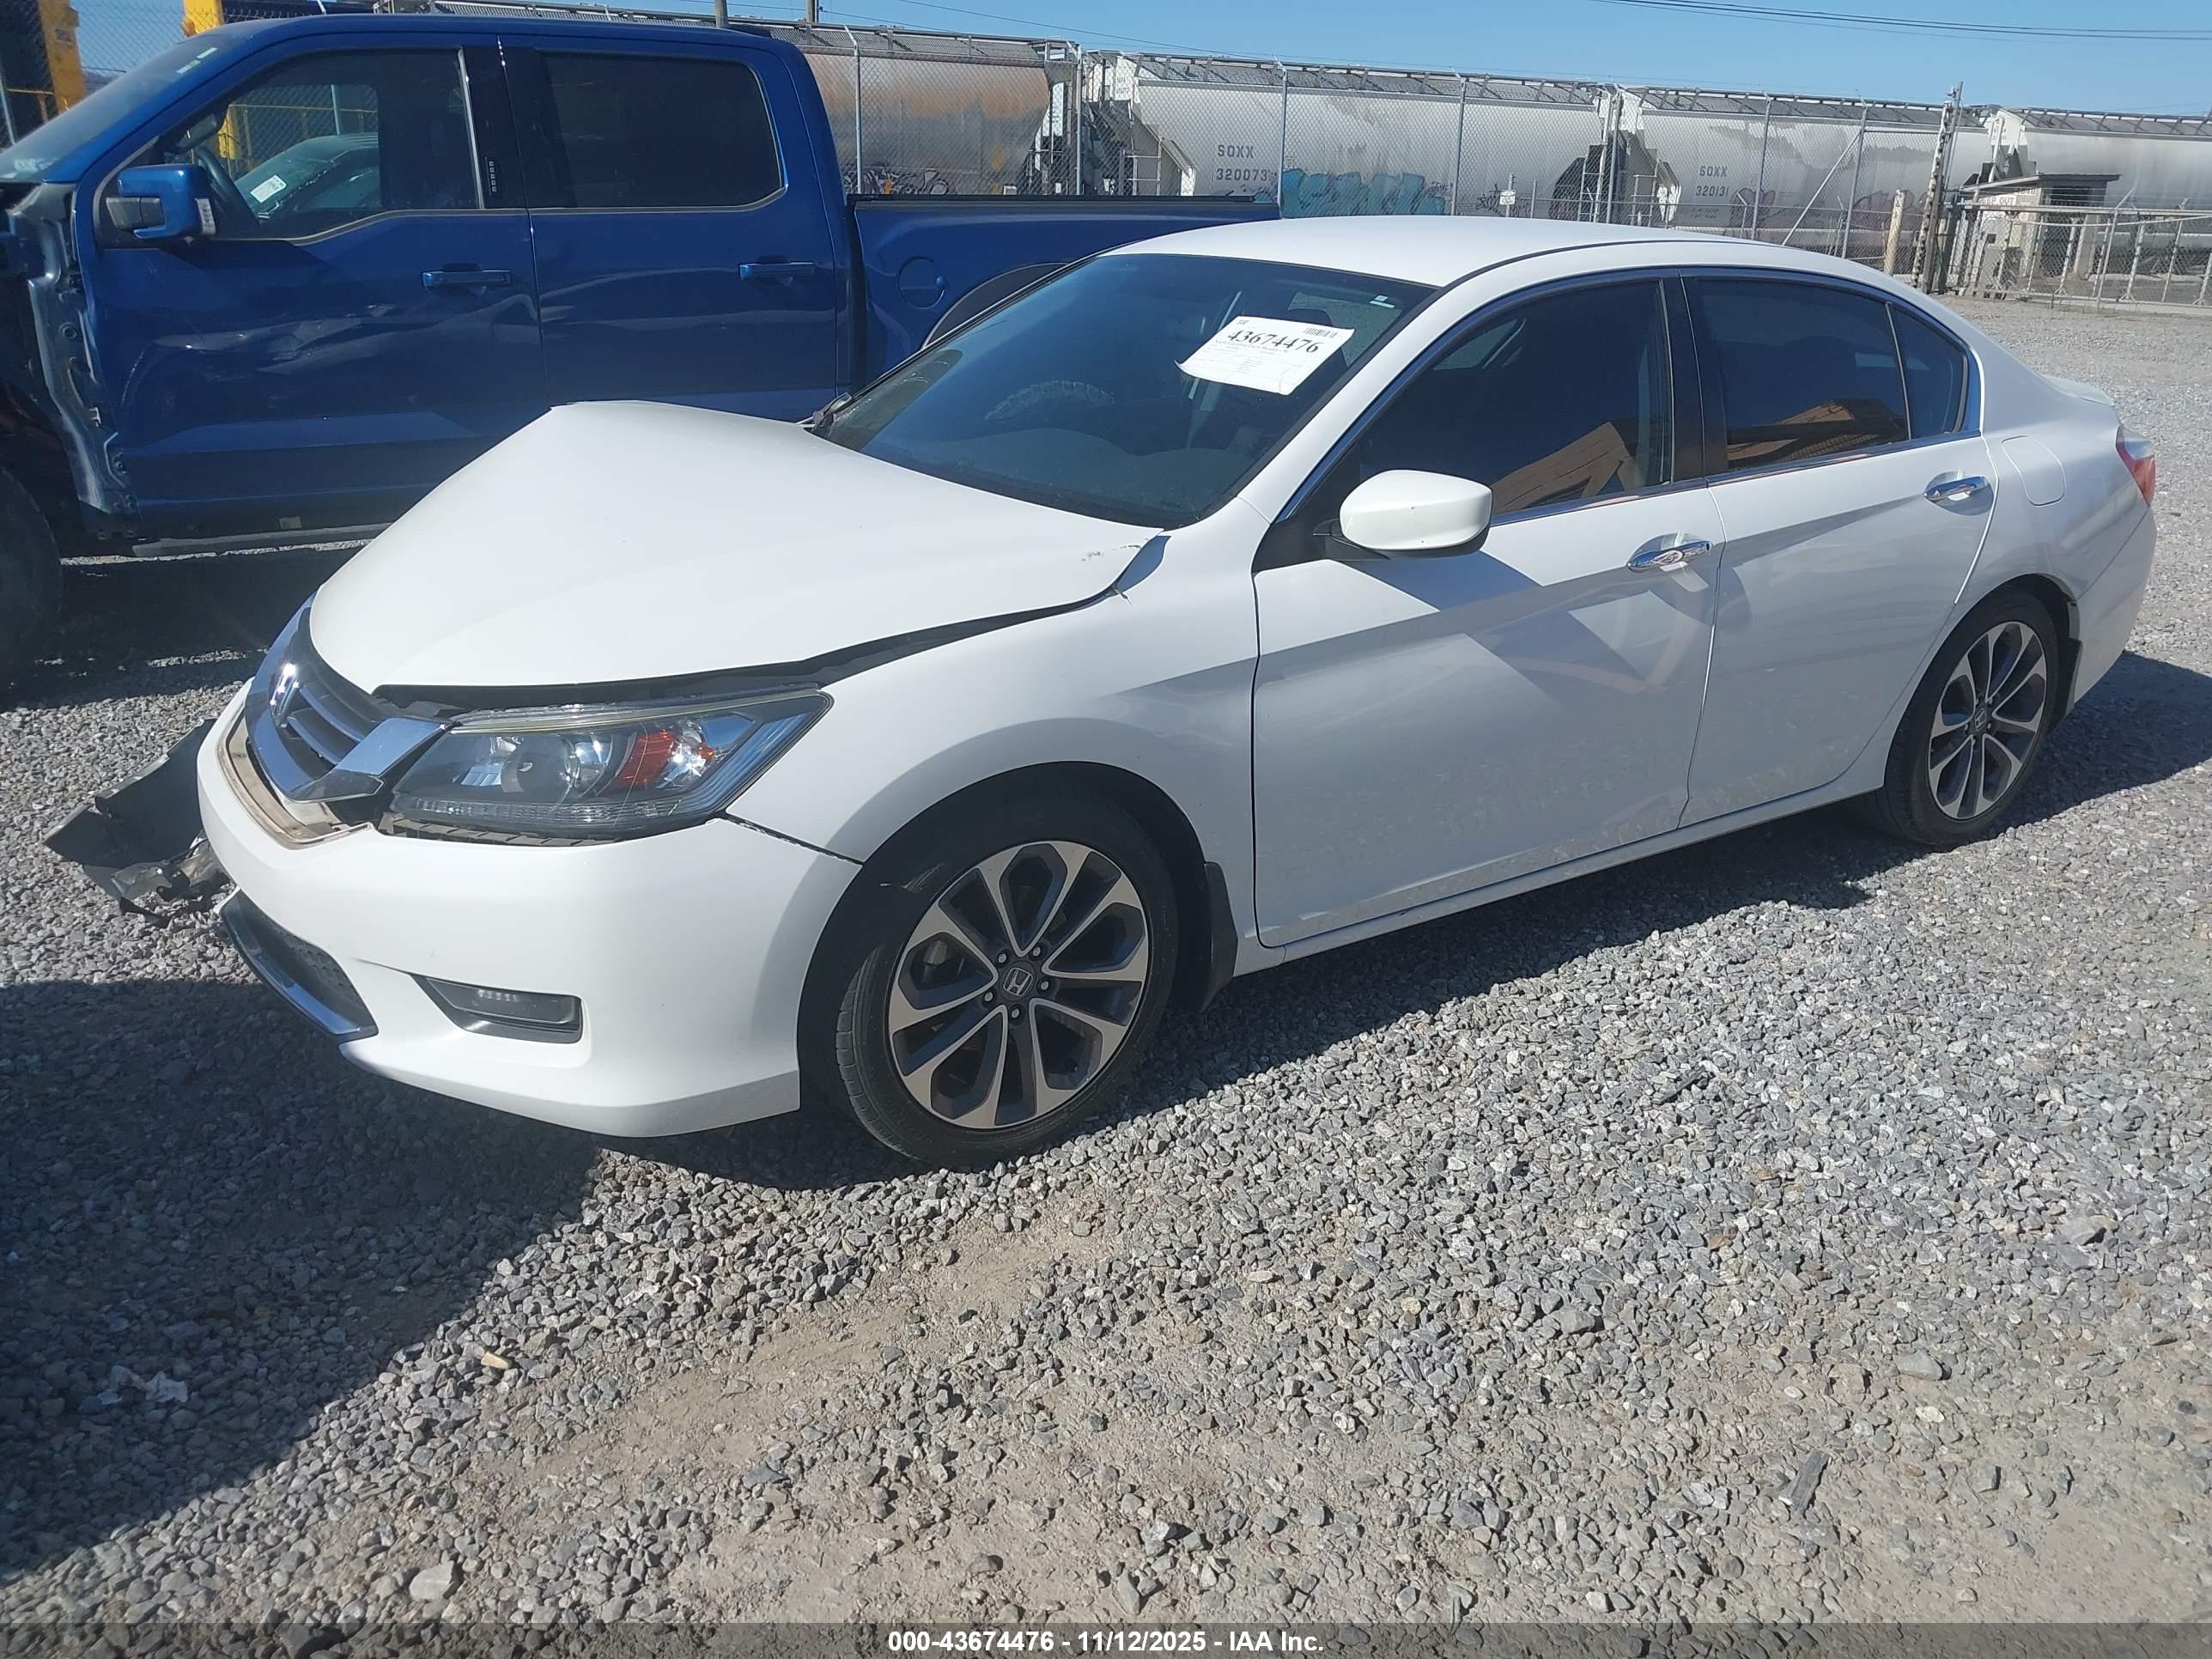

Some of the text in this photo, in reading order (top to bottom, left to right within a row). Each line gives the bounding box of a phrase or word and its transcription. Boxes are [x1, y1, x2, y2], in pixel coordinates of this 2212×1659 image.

[1218, 145, 1254, 158] SOXX
[1217, 168, 1267, 181] 320073
[1699, 166, 1728, 177] SOXX
[1696, 185, 1729, 197] 320131
[1999, 196, 2014, 206] OUT
[1228, 330, 1323, 353] 43674476
